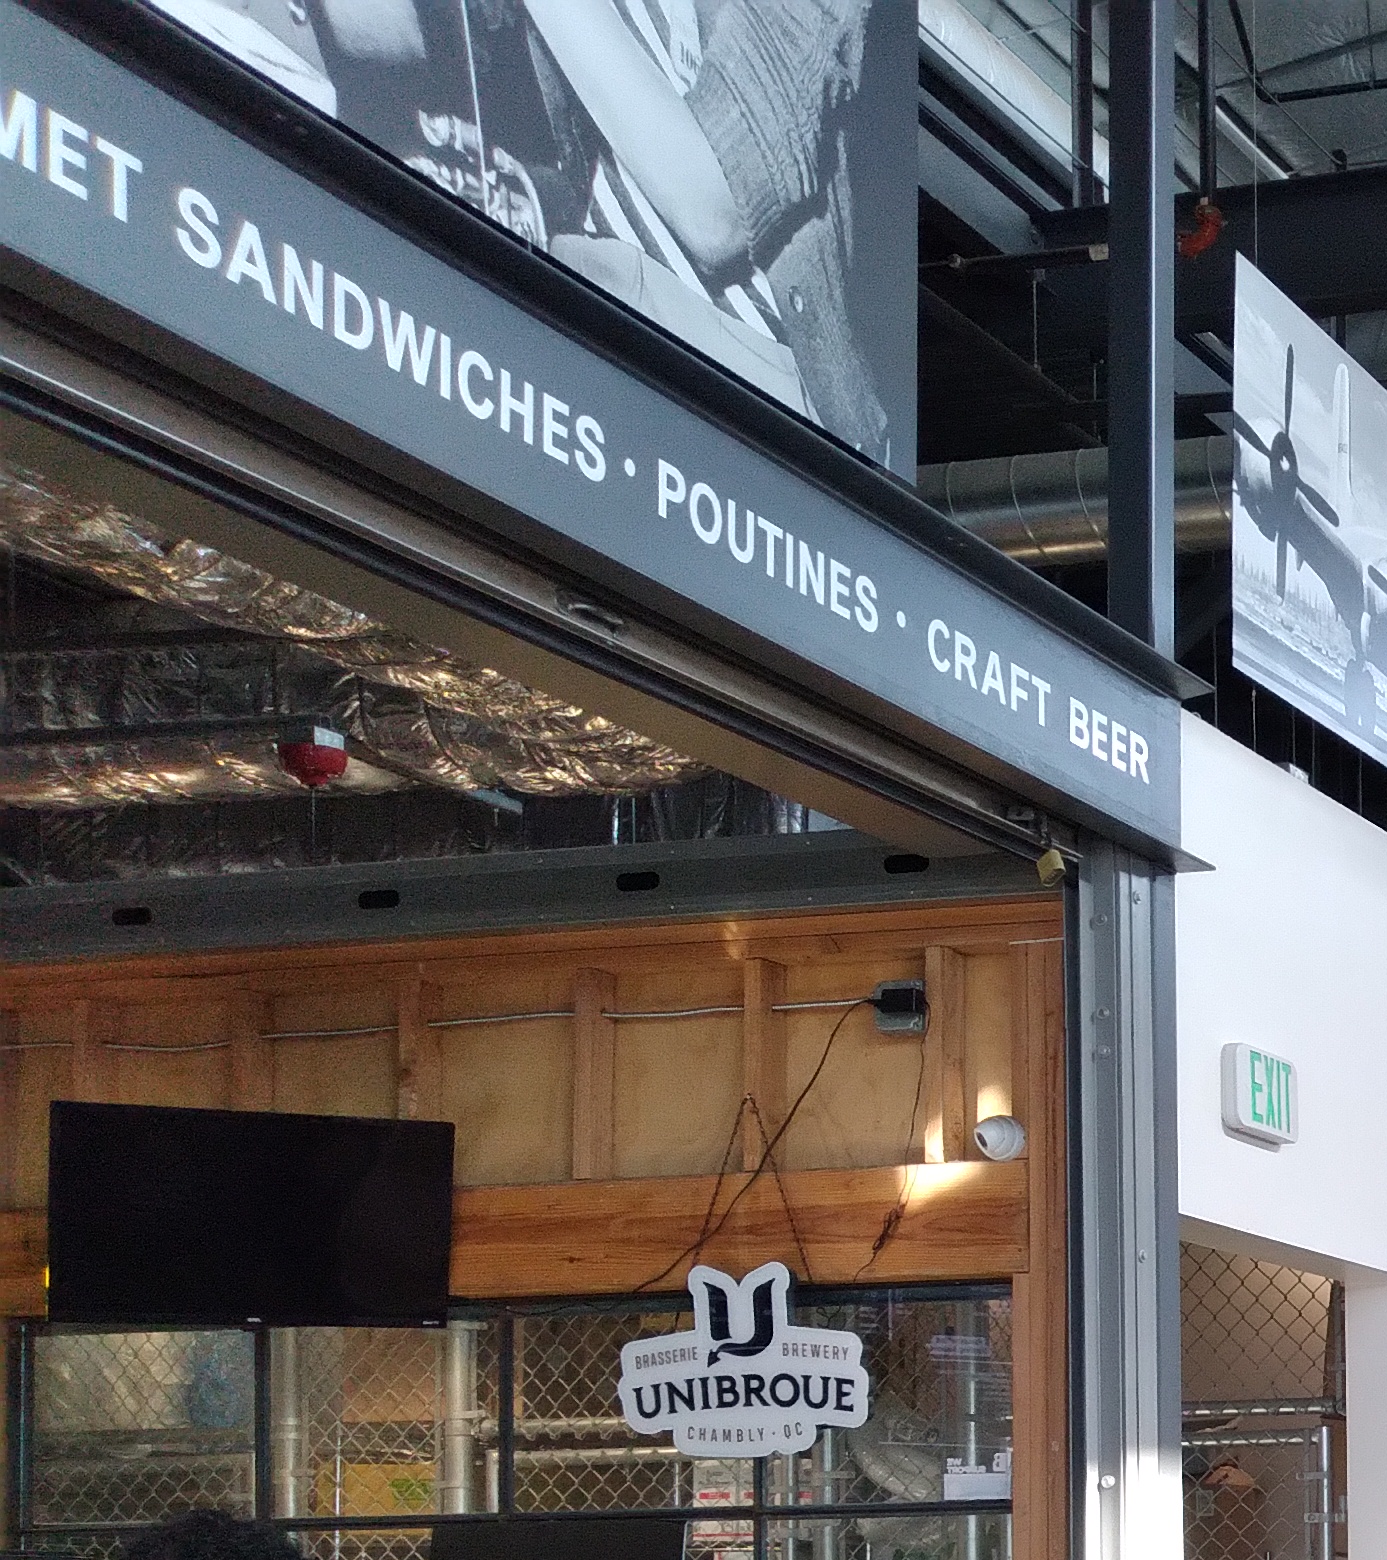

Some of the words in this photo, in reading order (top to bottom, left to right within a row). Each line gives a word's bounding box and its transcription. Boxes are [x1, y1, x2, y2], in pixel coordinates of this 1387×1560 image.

[174, 186, 607, 483] SANDWICHES
[656, 459, 881, 635] POUTINES
[927, 617, 1052, 729] CRAFT
[1069, 696, 1152, 785] BEER
[1250, 1050, 1291, 1134] EXIT
[634, 1345, 698, 1371] BRASSERIE
[782, 1342, 849, 1361] BREWERY
[632, 1372, 855, 1419] UNIBROUE
[687, 1426, 764, 1442] CHAMBLY
[783, 1422, 803, 1439] QC
